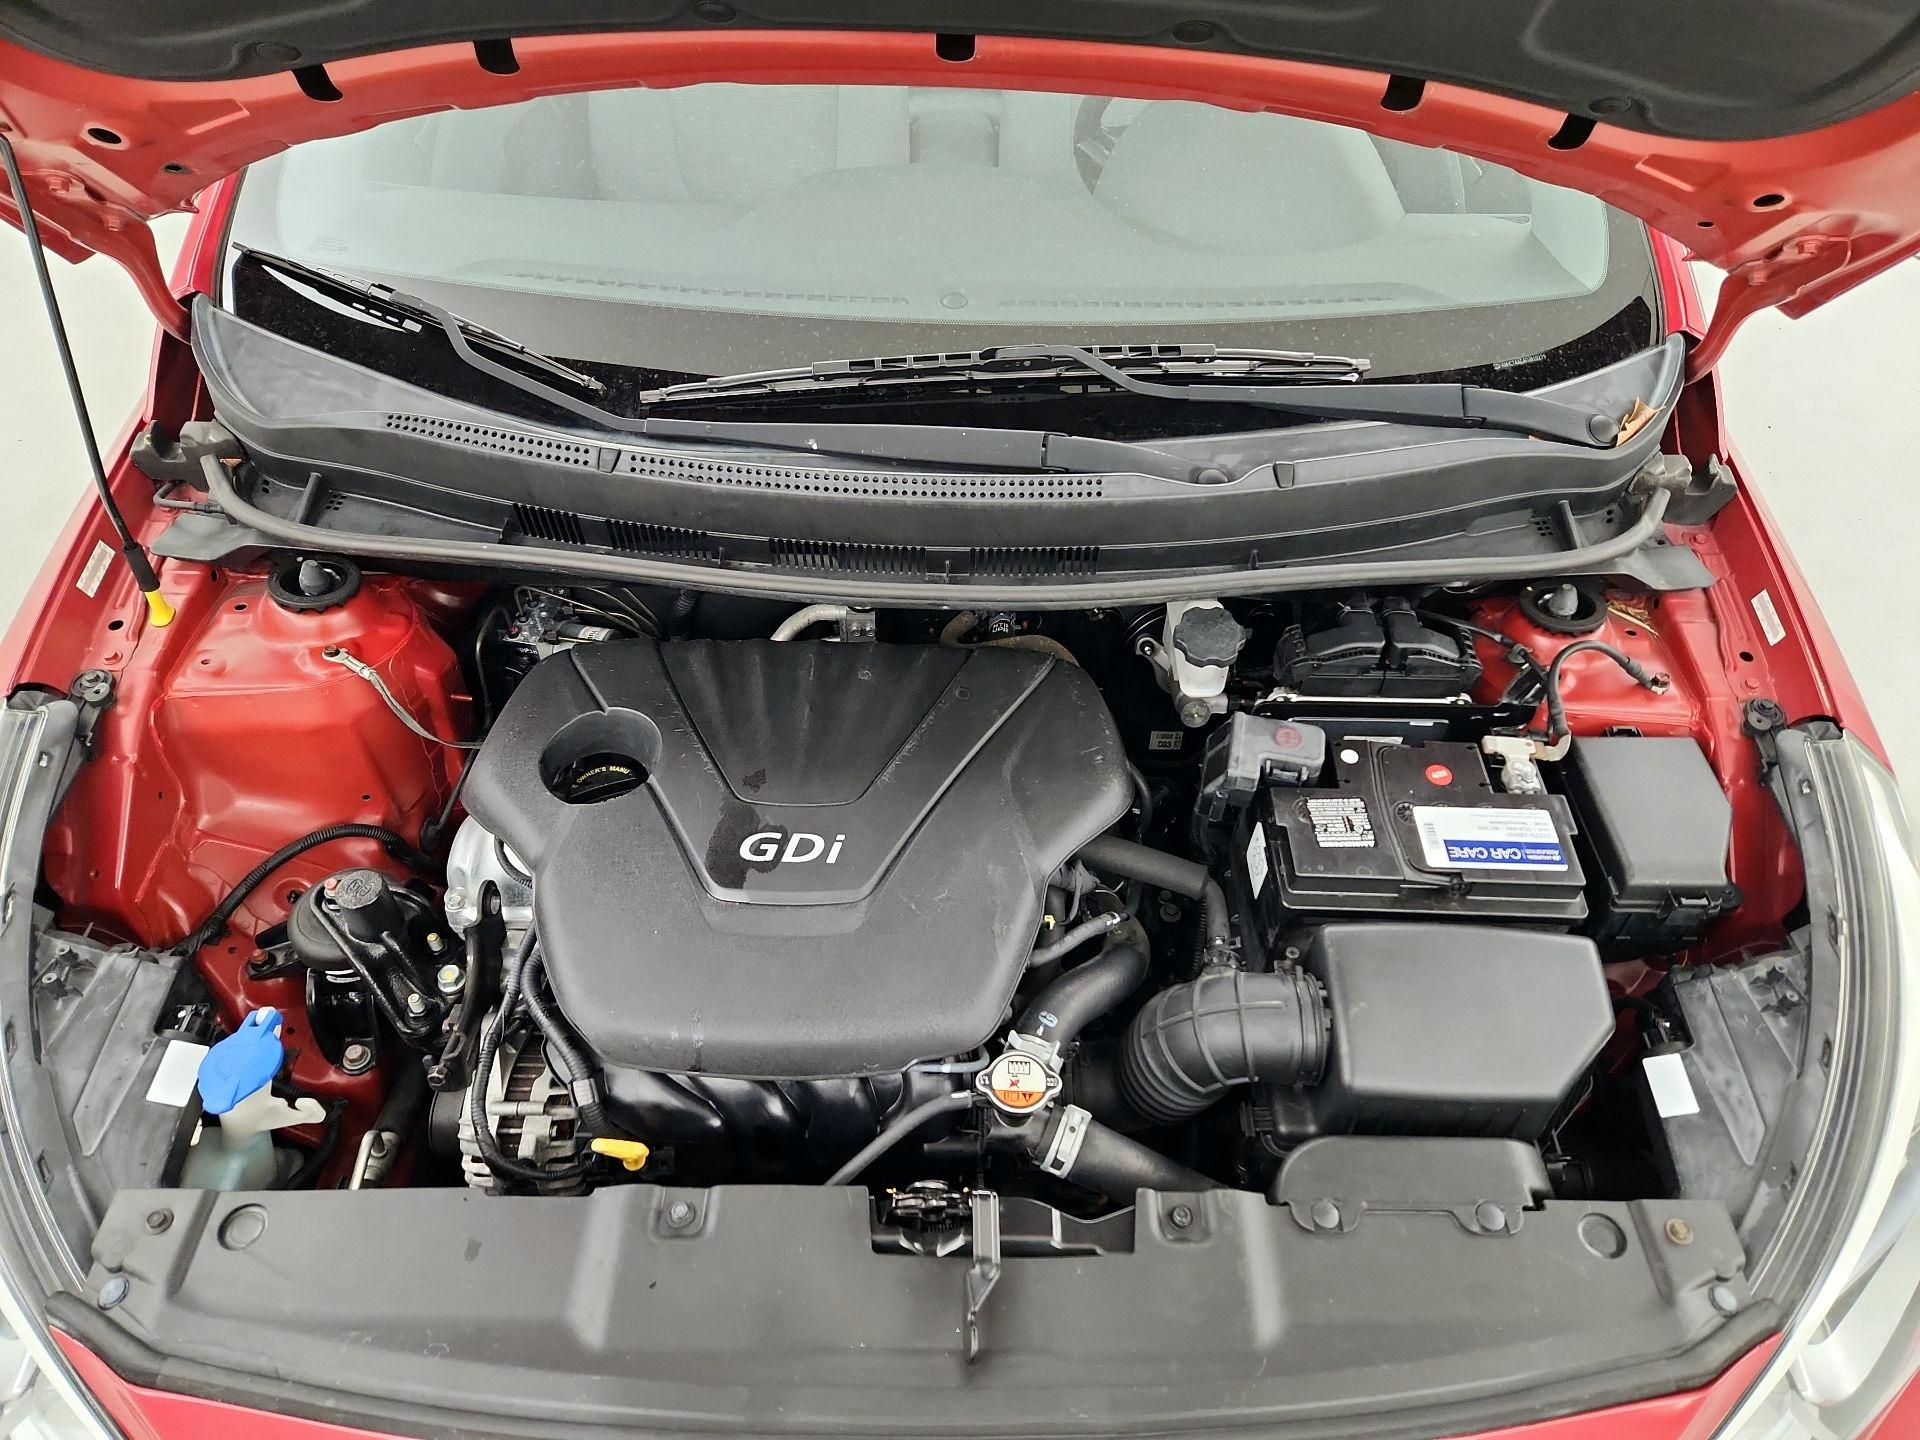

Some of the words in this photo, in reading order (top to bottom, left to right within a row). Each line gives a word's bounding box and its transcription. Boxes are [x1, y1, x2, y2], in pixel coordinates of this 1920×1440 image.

[576, 766, 607, 783] OWNER'S
[739, 831, 846, 864] GDi
[1447, 846, 1488, 860] CARE
[1490, 847, 1522, 860] CAR
